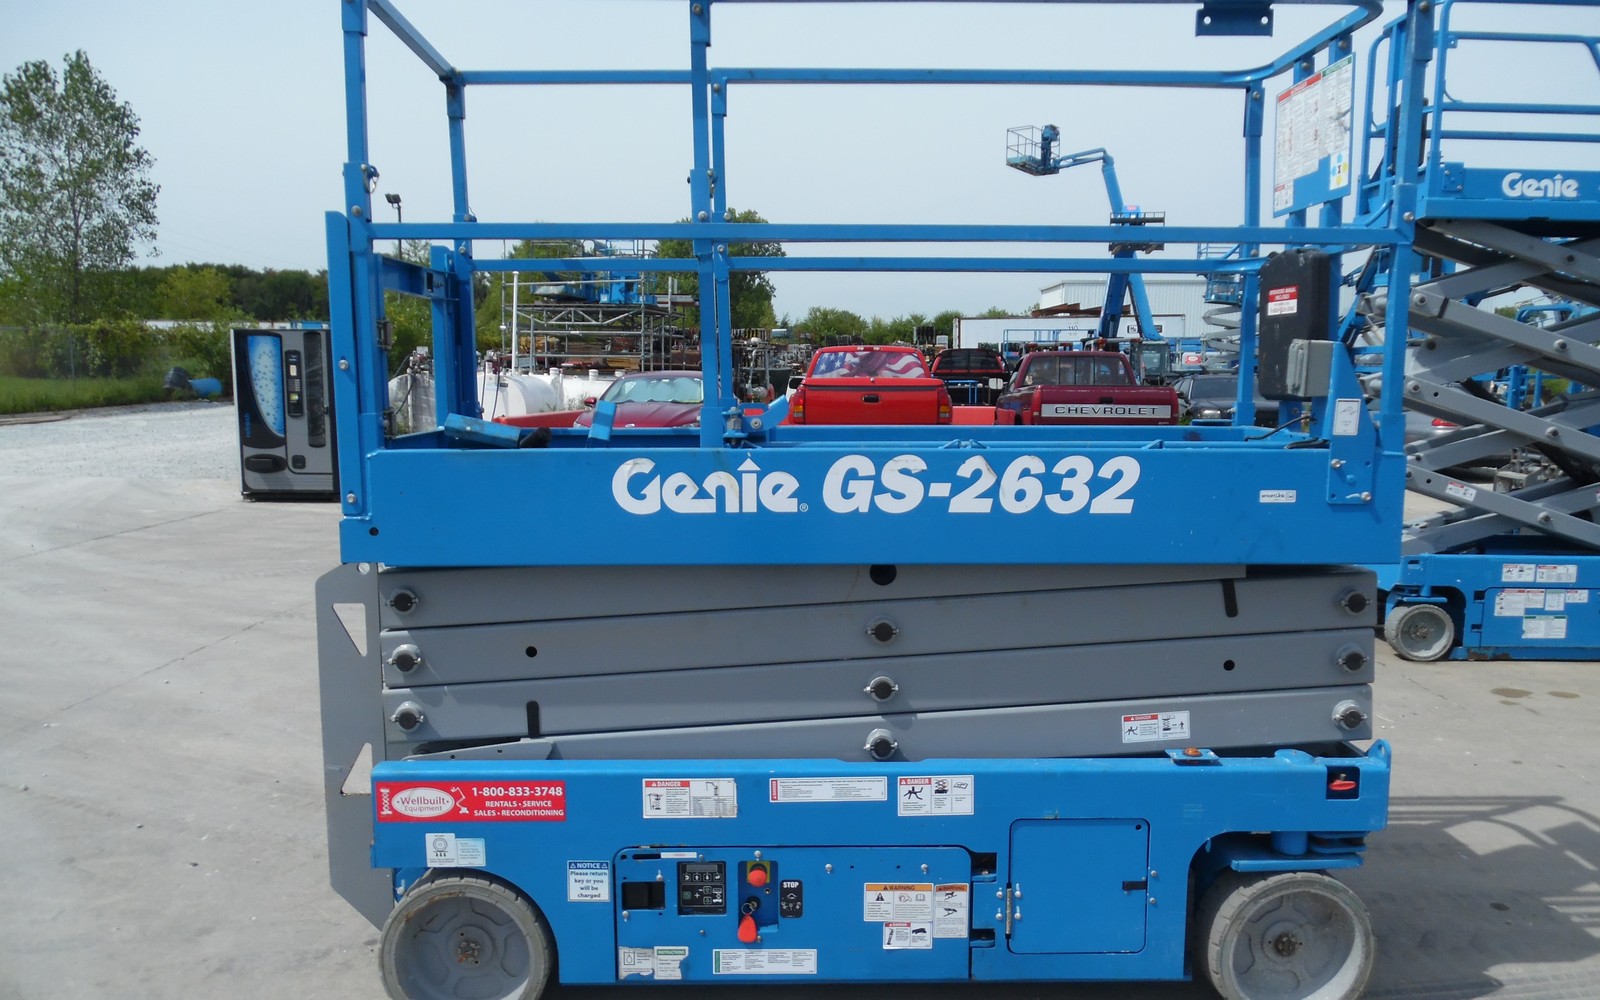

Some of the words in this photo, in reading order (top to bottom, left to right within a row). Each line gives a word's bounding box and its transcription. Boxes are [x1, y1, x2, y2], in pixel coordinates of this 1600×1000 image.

[1502, 172, 1578, 197] Genie
[1055, 406, 1158, 415] CHEVROLET
[611, 456, 799, 514] Genie
[822, 454, 1141, 514] GS-2632
[471, 786, 563, 796] 1-800-833-3748
[400, 796, 446, 805] Wellbuilt
